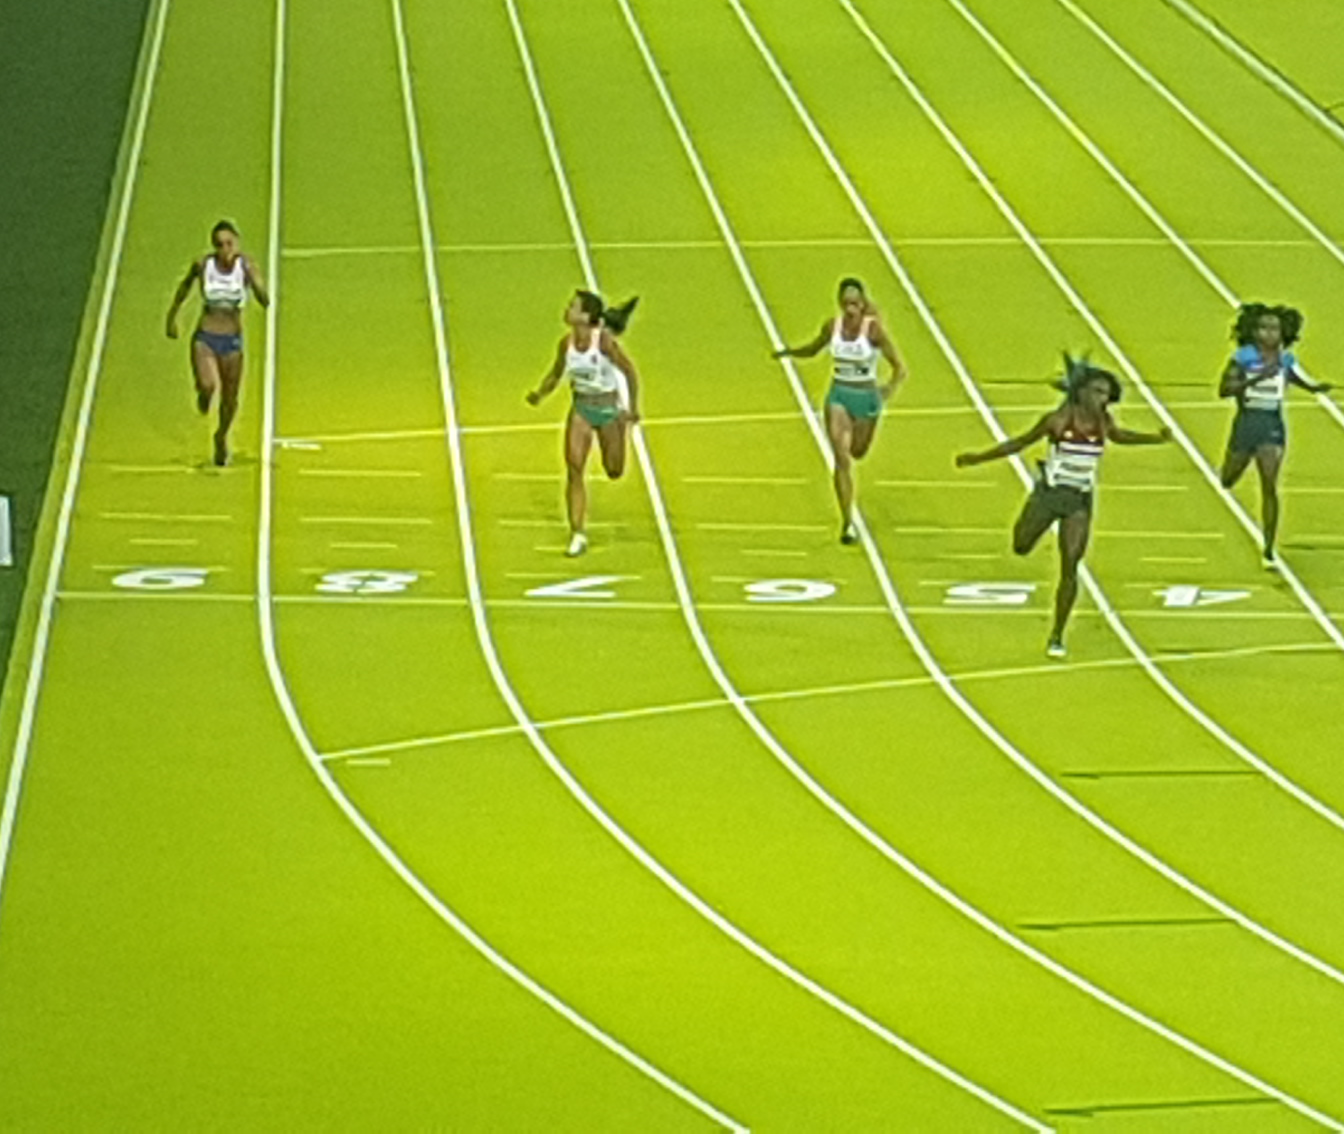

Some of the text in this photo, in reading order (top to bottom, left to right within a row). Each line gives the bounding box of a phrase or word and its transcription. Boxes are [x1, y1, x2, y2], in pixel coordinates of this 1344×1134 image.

[315, 570, 419, 594] 8
[524, 575, 625, 599] 7
[943, 583, 1036, 606] 5
[1152, 585, 1253, 608] 4
